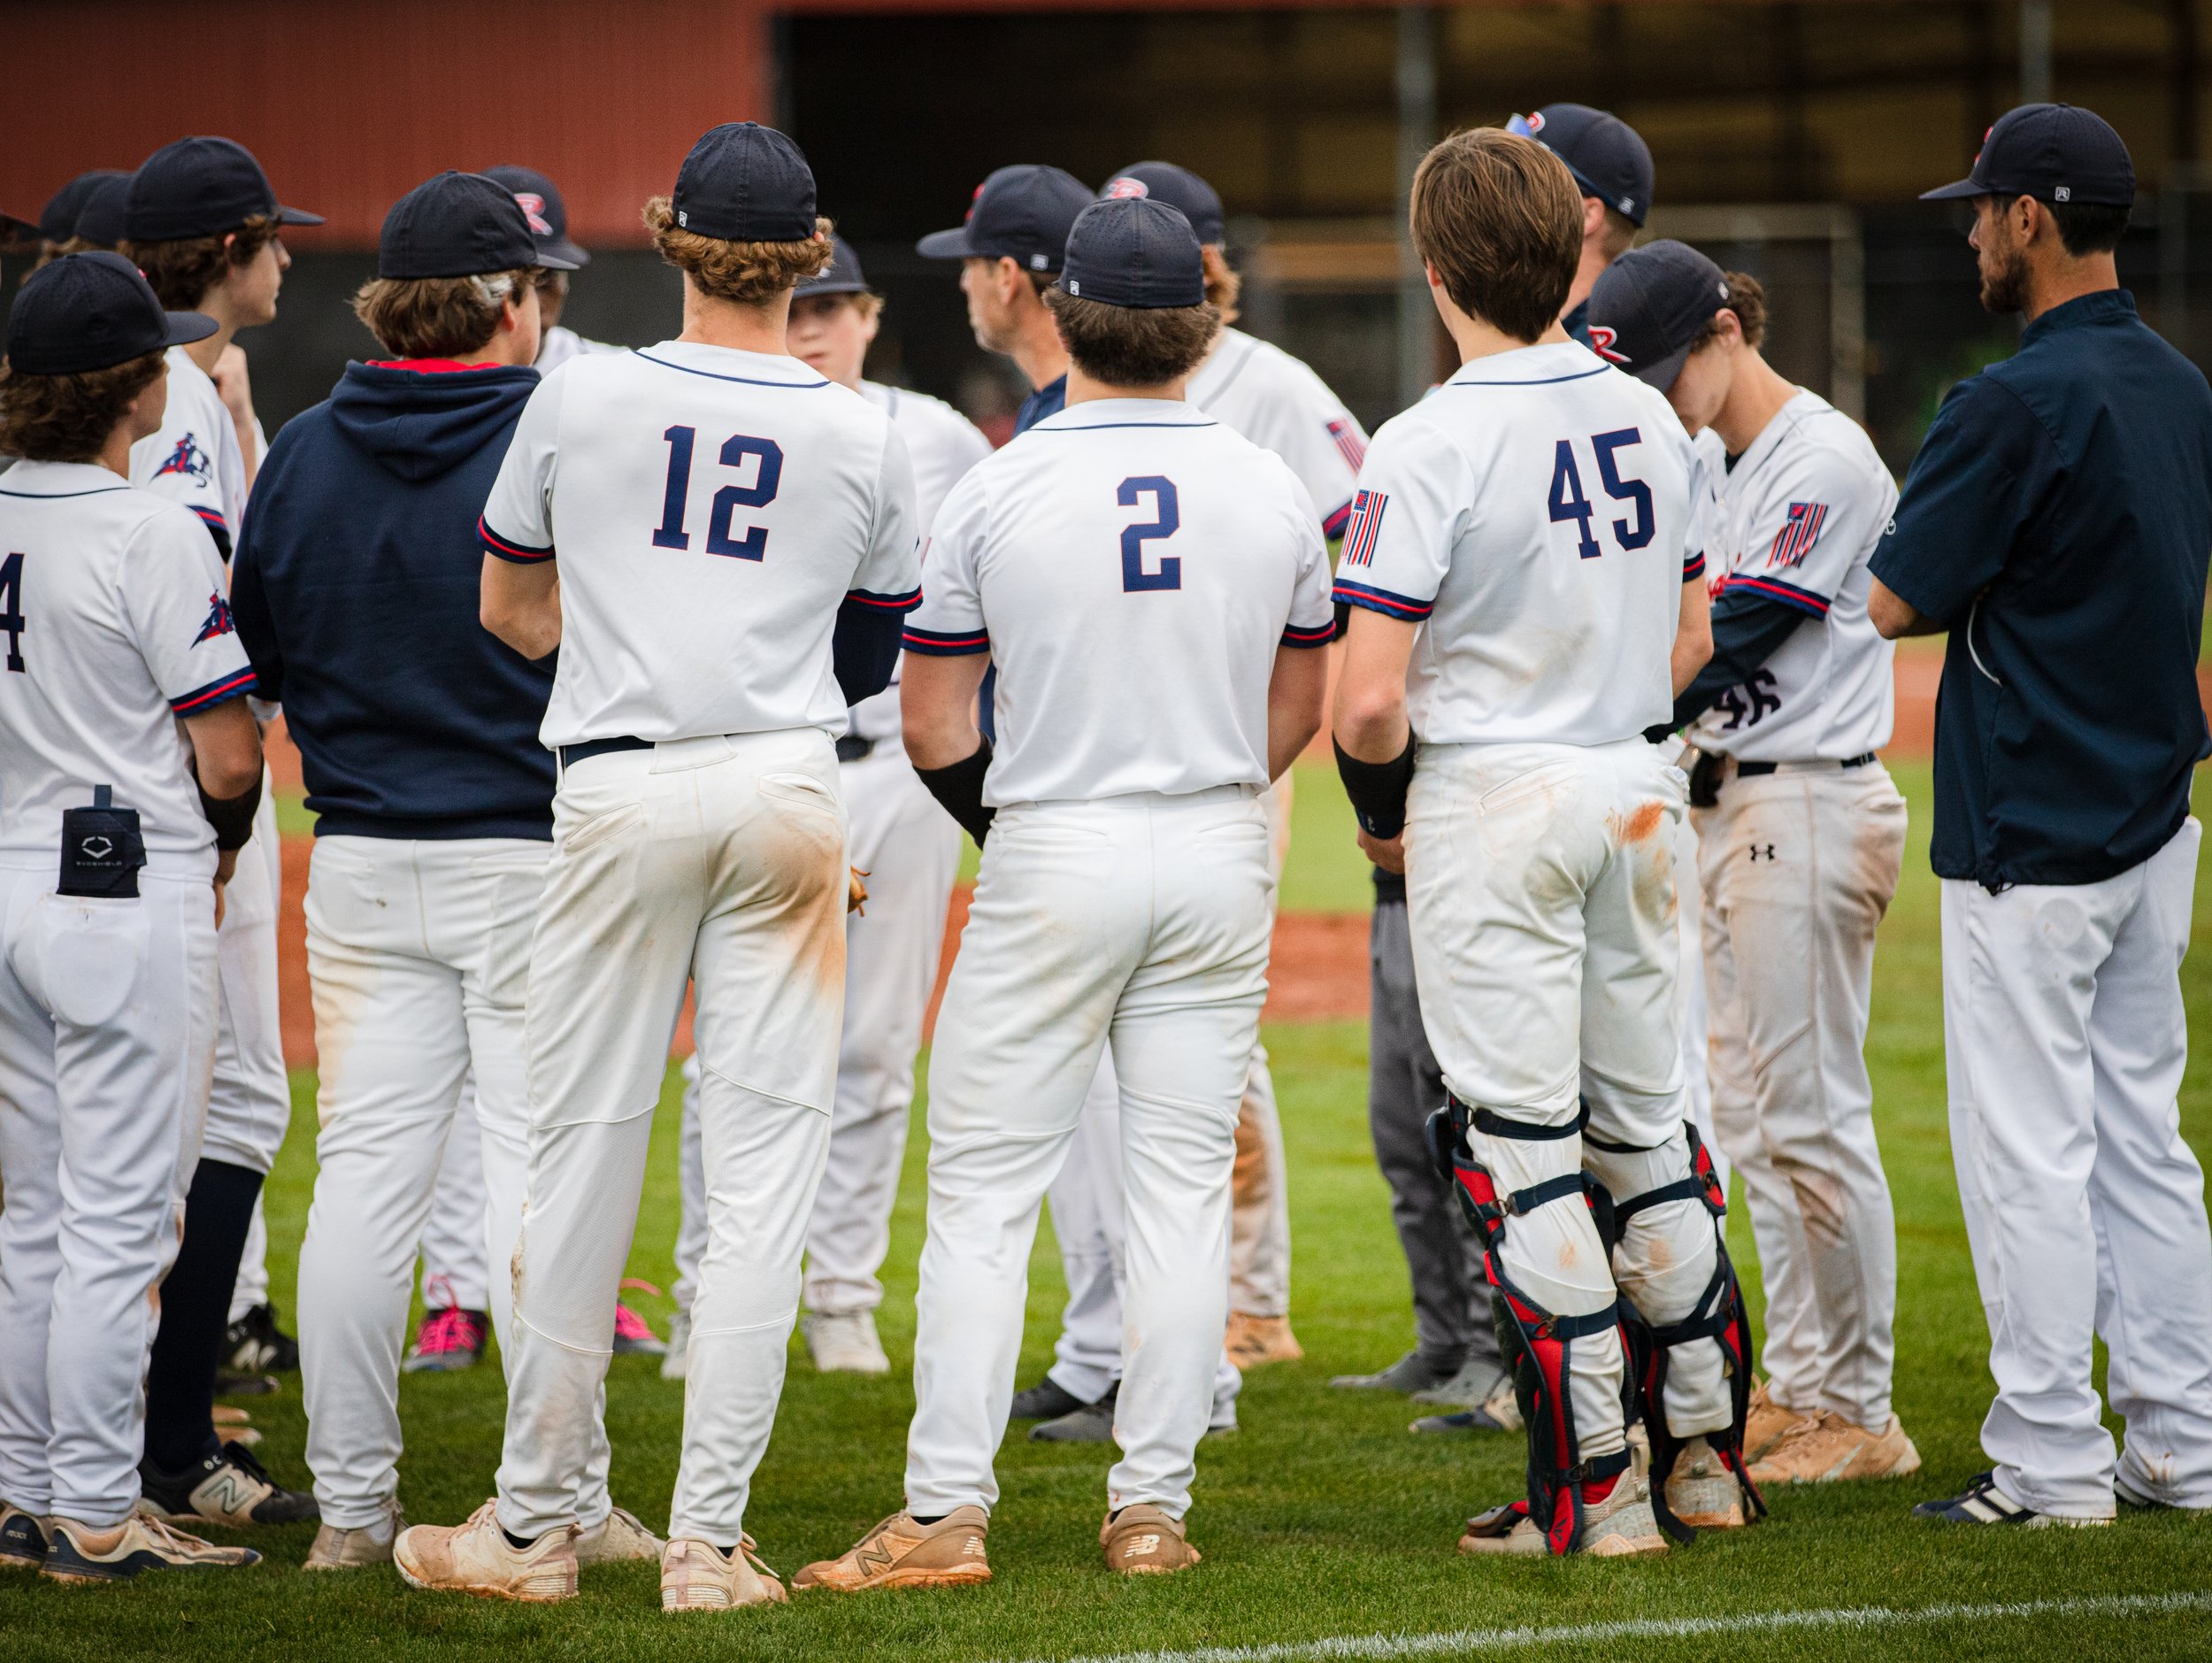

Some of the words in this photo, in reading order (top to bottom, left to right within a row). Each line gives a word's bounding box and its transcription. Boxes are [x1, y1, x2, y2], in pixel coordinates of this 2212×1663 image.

[1586, 324, 1632, 363] R
[652, 424, 784, 563] 12
[1117, 475, 1181, 592] 2
[1548, 427, 1655, 559] 45
[0, 551, 26, 673] 4
